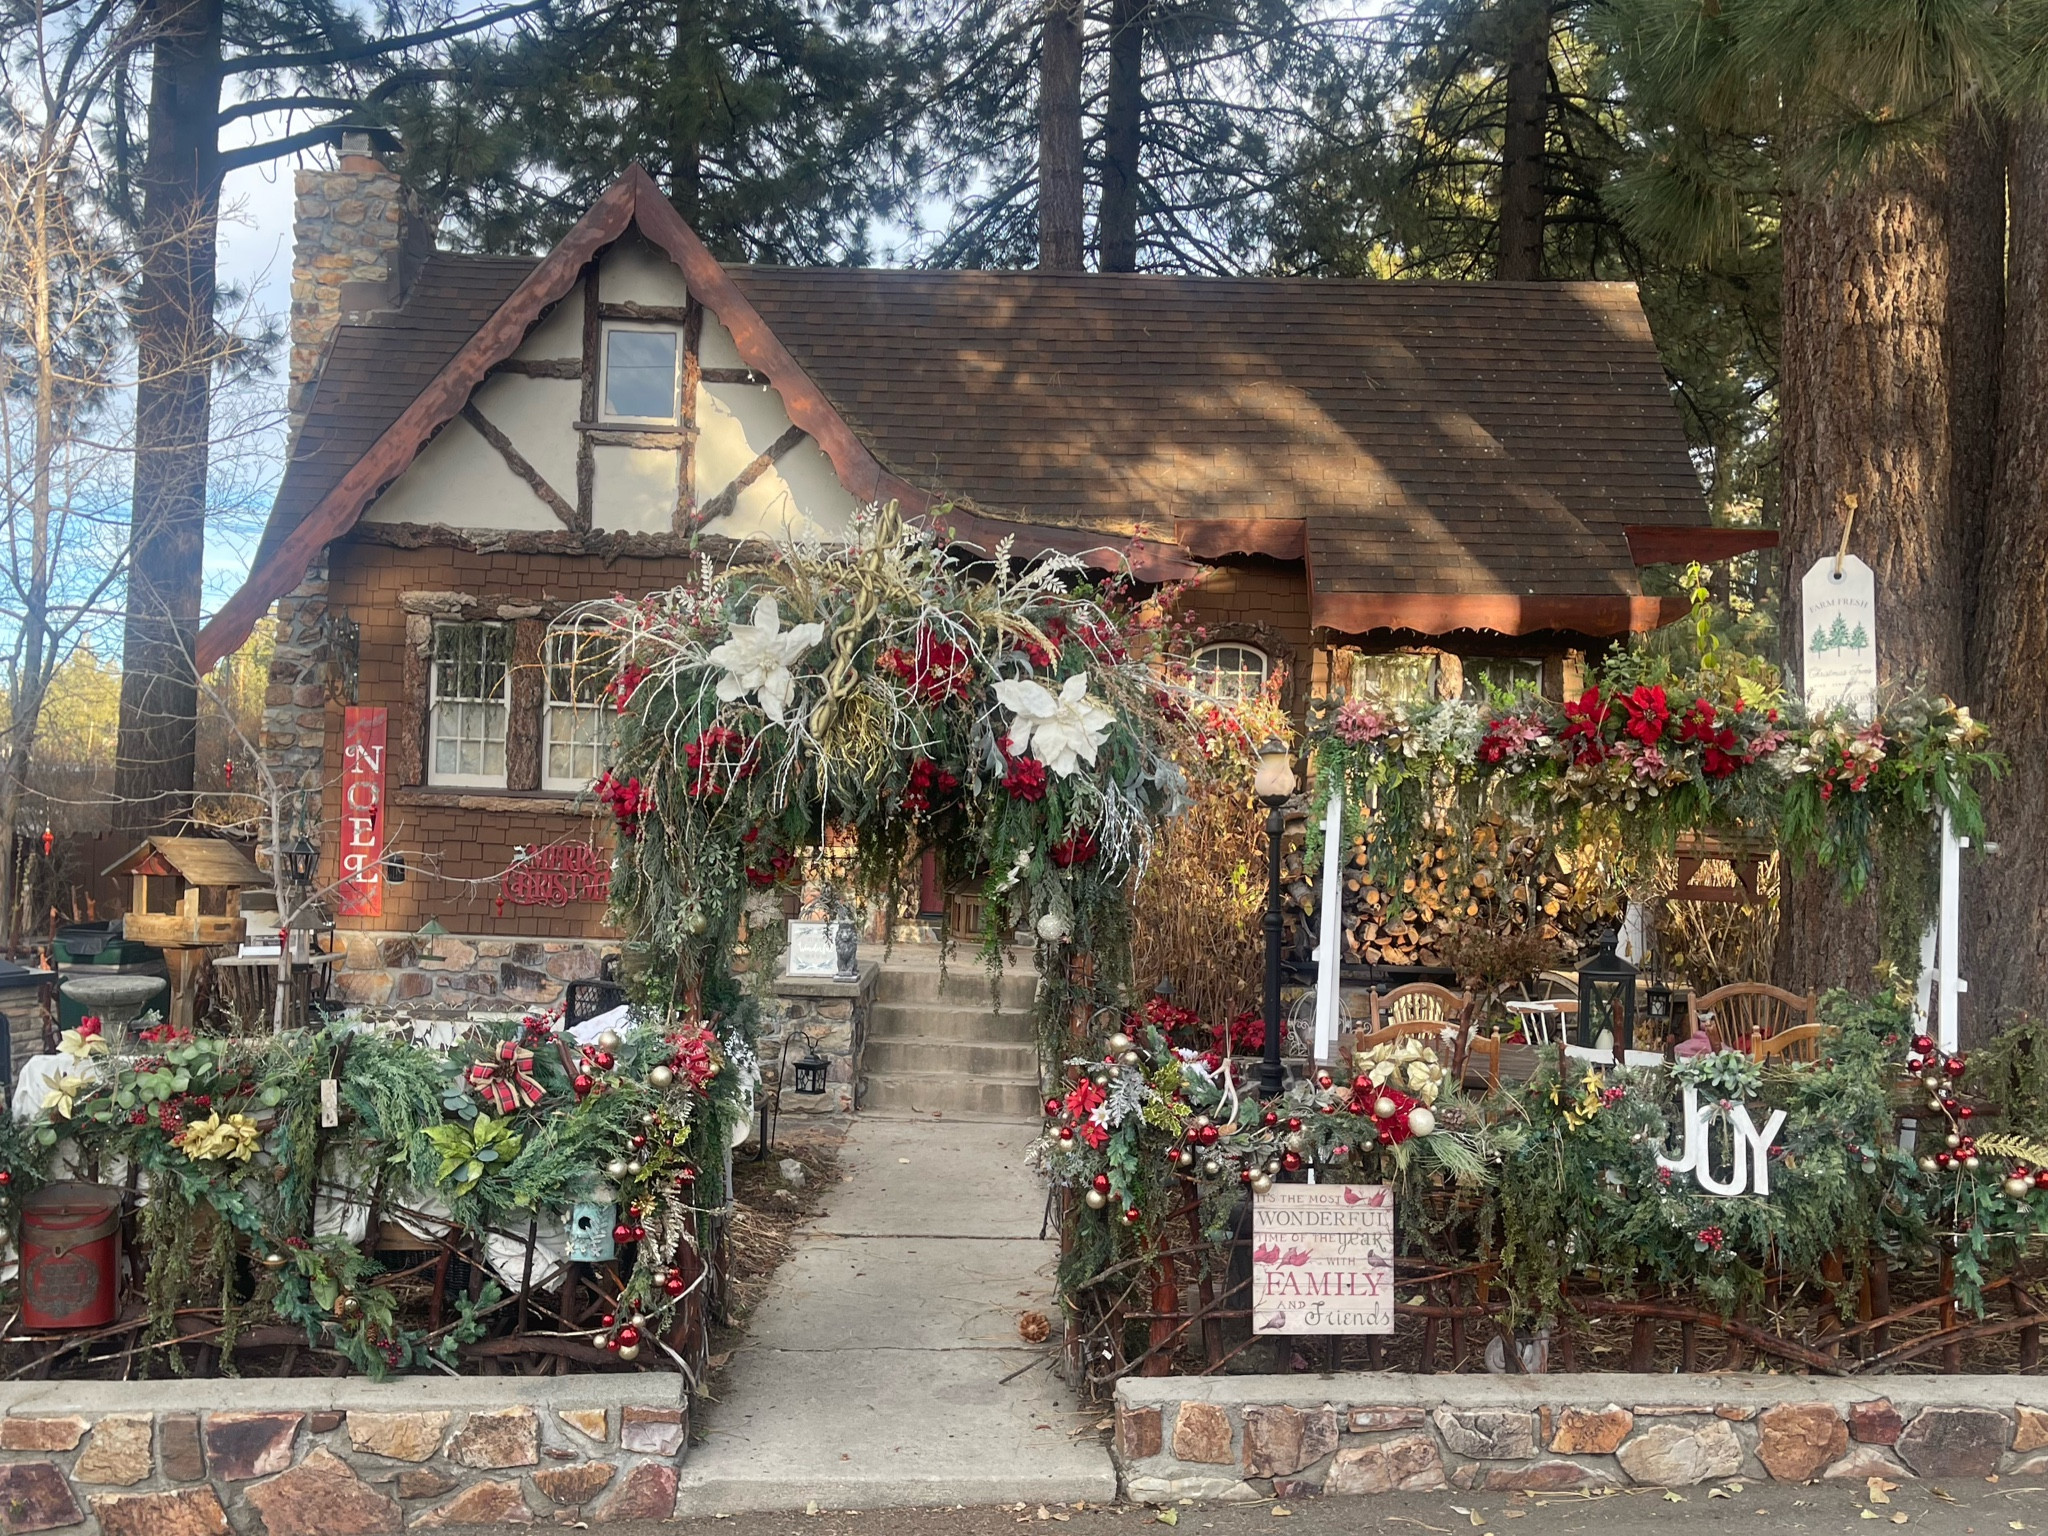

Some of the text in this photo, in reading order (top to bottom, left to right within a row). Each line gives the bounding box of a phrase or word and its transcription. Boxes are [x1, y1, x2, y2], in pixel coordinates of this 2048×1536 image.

[344, 744, 384, 884] NOEL
[525, 842, 608, 873] MERRY
[502, 862, 611, 908] CHRISTMA
[1654, 1082, 1788, 1196] JOY
[1256, 1193, 1342, 1205] IT'S THE MOST
[1257, 1210, 1389, 1227] WONDERFUL
[1257, 1233, 1287, 1243] TIME
[1291, 1232, 1305, 1243] OF
[1312, 1233, 1337, 1243] THE
[1326, 1257, 1356, 1266] WITH
[1265, 1271, 1385, 1297] FAMILY
[1277, 1301, 1390, 1326] AND Friends
